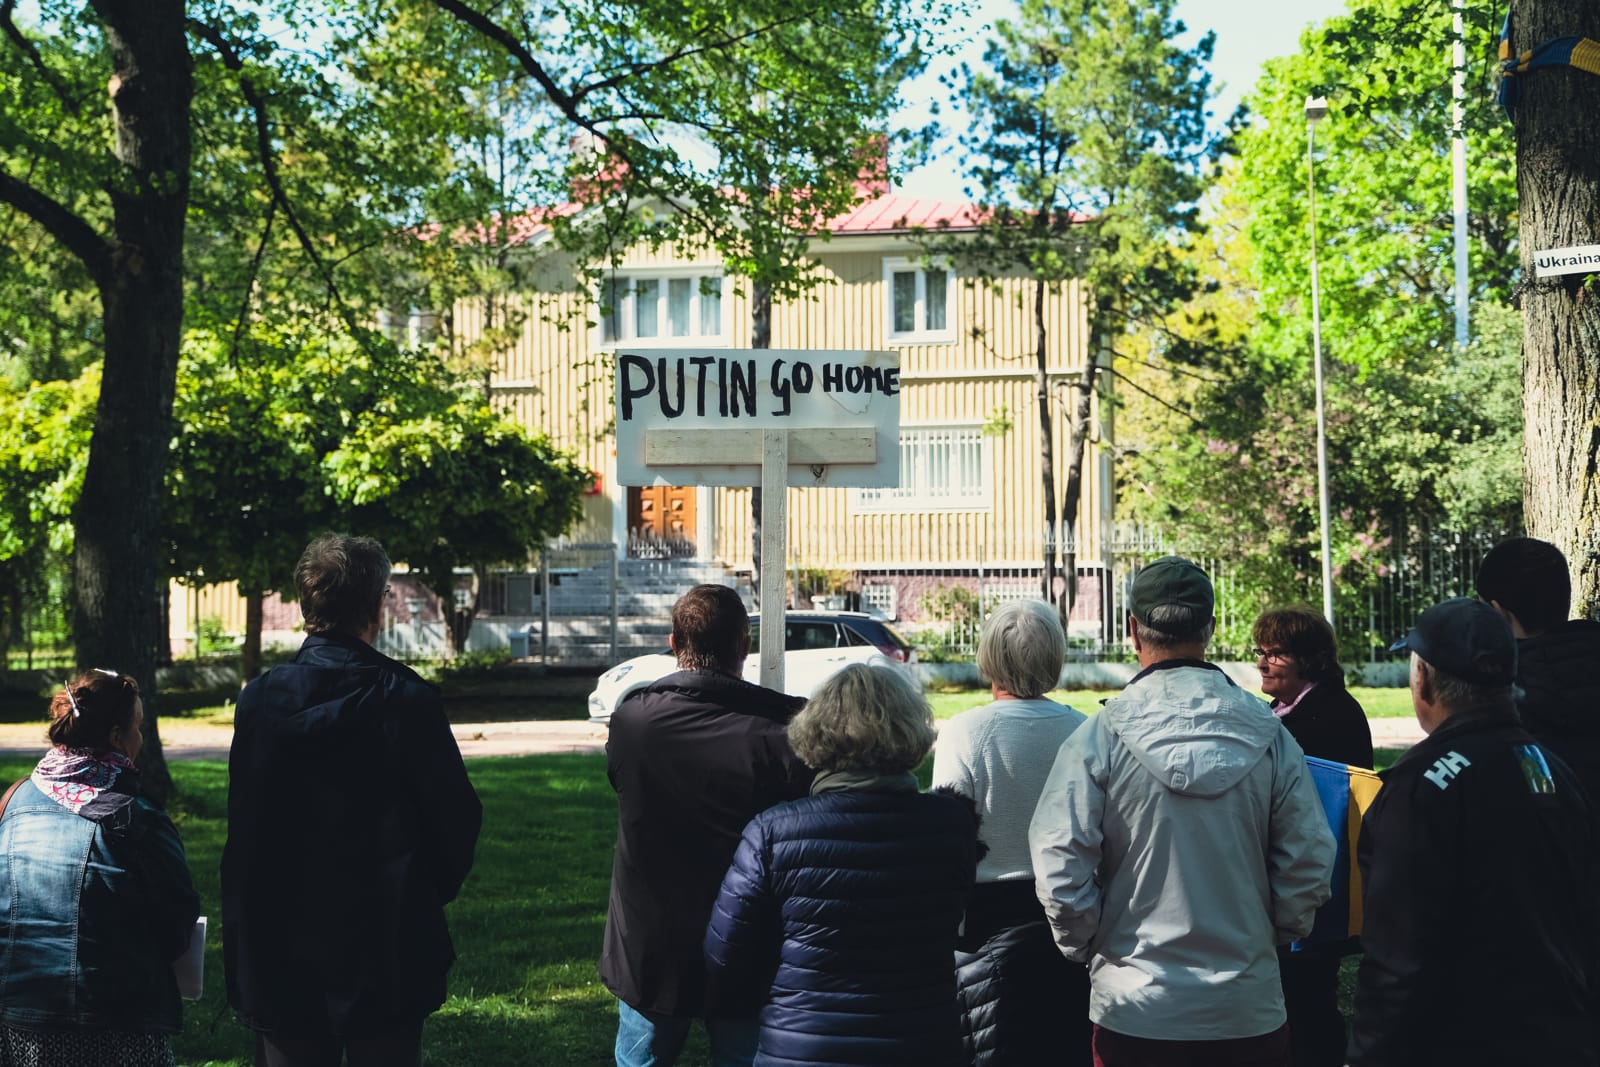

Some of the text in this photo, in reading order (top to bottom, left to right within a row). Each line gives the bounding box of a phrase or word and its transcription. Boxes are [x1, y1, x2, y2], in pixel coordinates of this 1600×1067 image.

[619, 354, 900, 421] PUTIN GO HOME
[1423, 751, 1472, 791] HH
